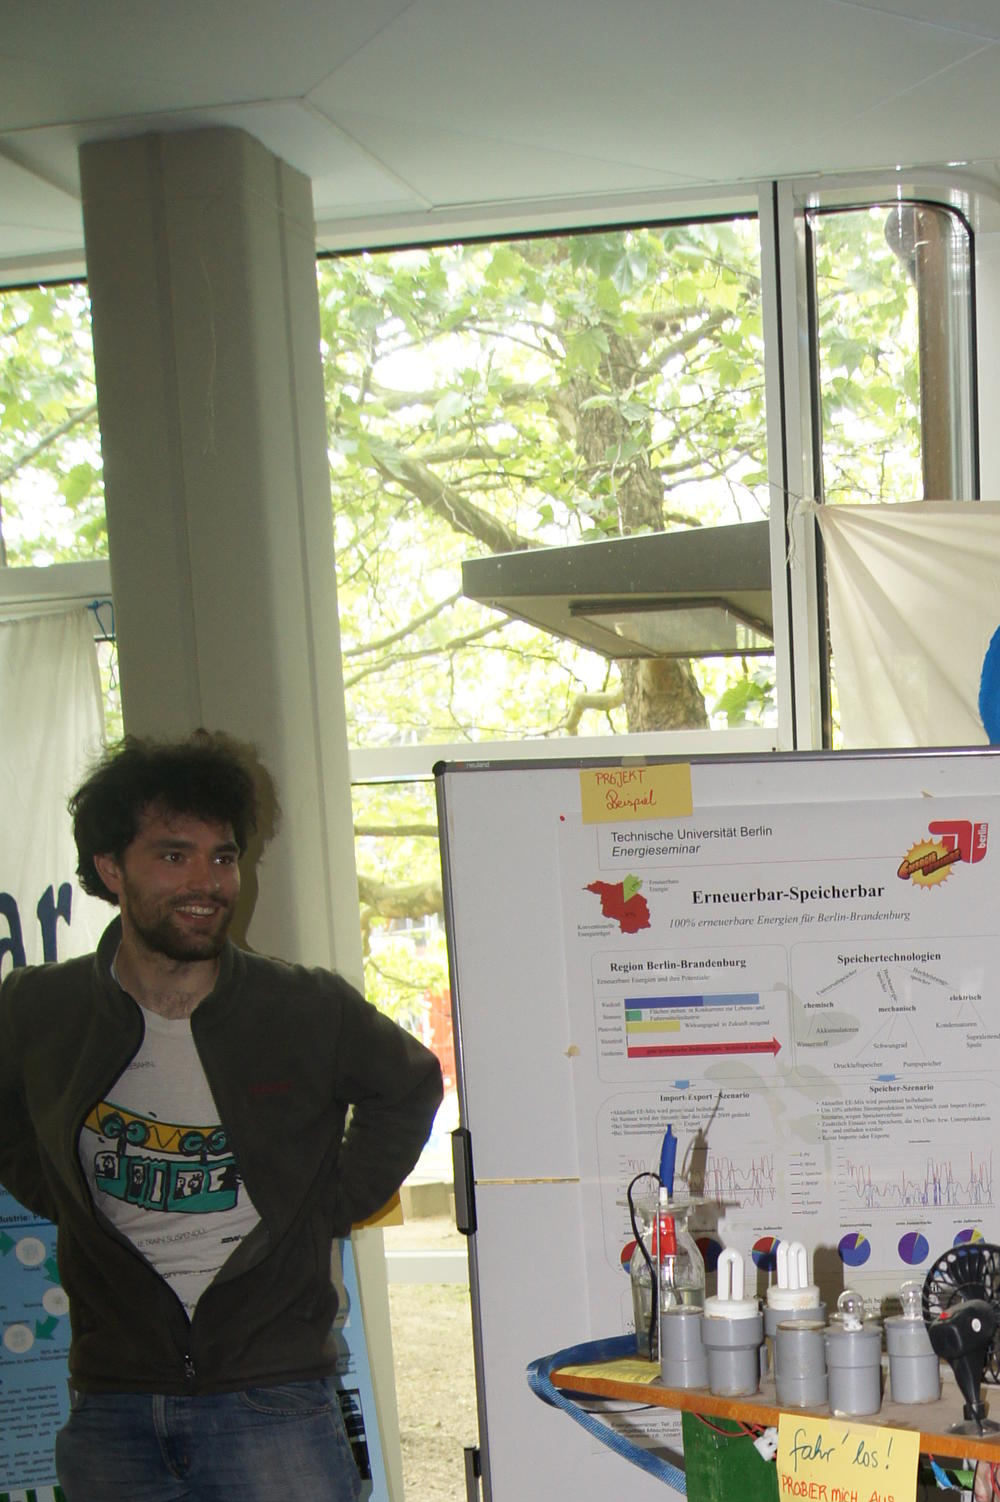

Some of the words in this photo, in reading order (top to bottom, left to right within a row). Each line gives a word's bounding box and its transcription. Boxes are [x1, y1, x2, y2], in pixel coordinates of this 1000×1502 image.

[595, 769, 647, 788] PROJEKT
[605, 789, 657, 812] Beispiel
[611, 831, 673, 843] Technische
[677, 827, 737, 840] Universität
[740, 826, 773, 838] Berlin
[977, 823, 987, 849] berlin
[612, 844, 701, 858] Energieseminar
[692, 884, 886, 905] Erneuerbar-Speicherbar
[669, 917, 696, 929] 100%
[698, 916, 754, 928] erneuerbare
[757, 914, 799, 926] Energien
[800, 912, 815, 925] für
[817, 910, 911, 924] Berlin-Brandenburg
[610, 961, 644, 974] Region
[646, 958, 747, 973] Berlin-Brandenburg
[837, 952, 941, 966] Speichertechnologien
[803, 1001, 834, 1010] chemisch
[878, 1005, 916, 1013] mechanisch
[949, 994, 982, 1002] elektrisch
[869, 1084, 934, 1094] Speicher-Szenario
[852, 1436, 893, 1471] los!
